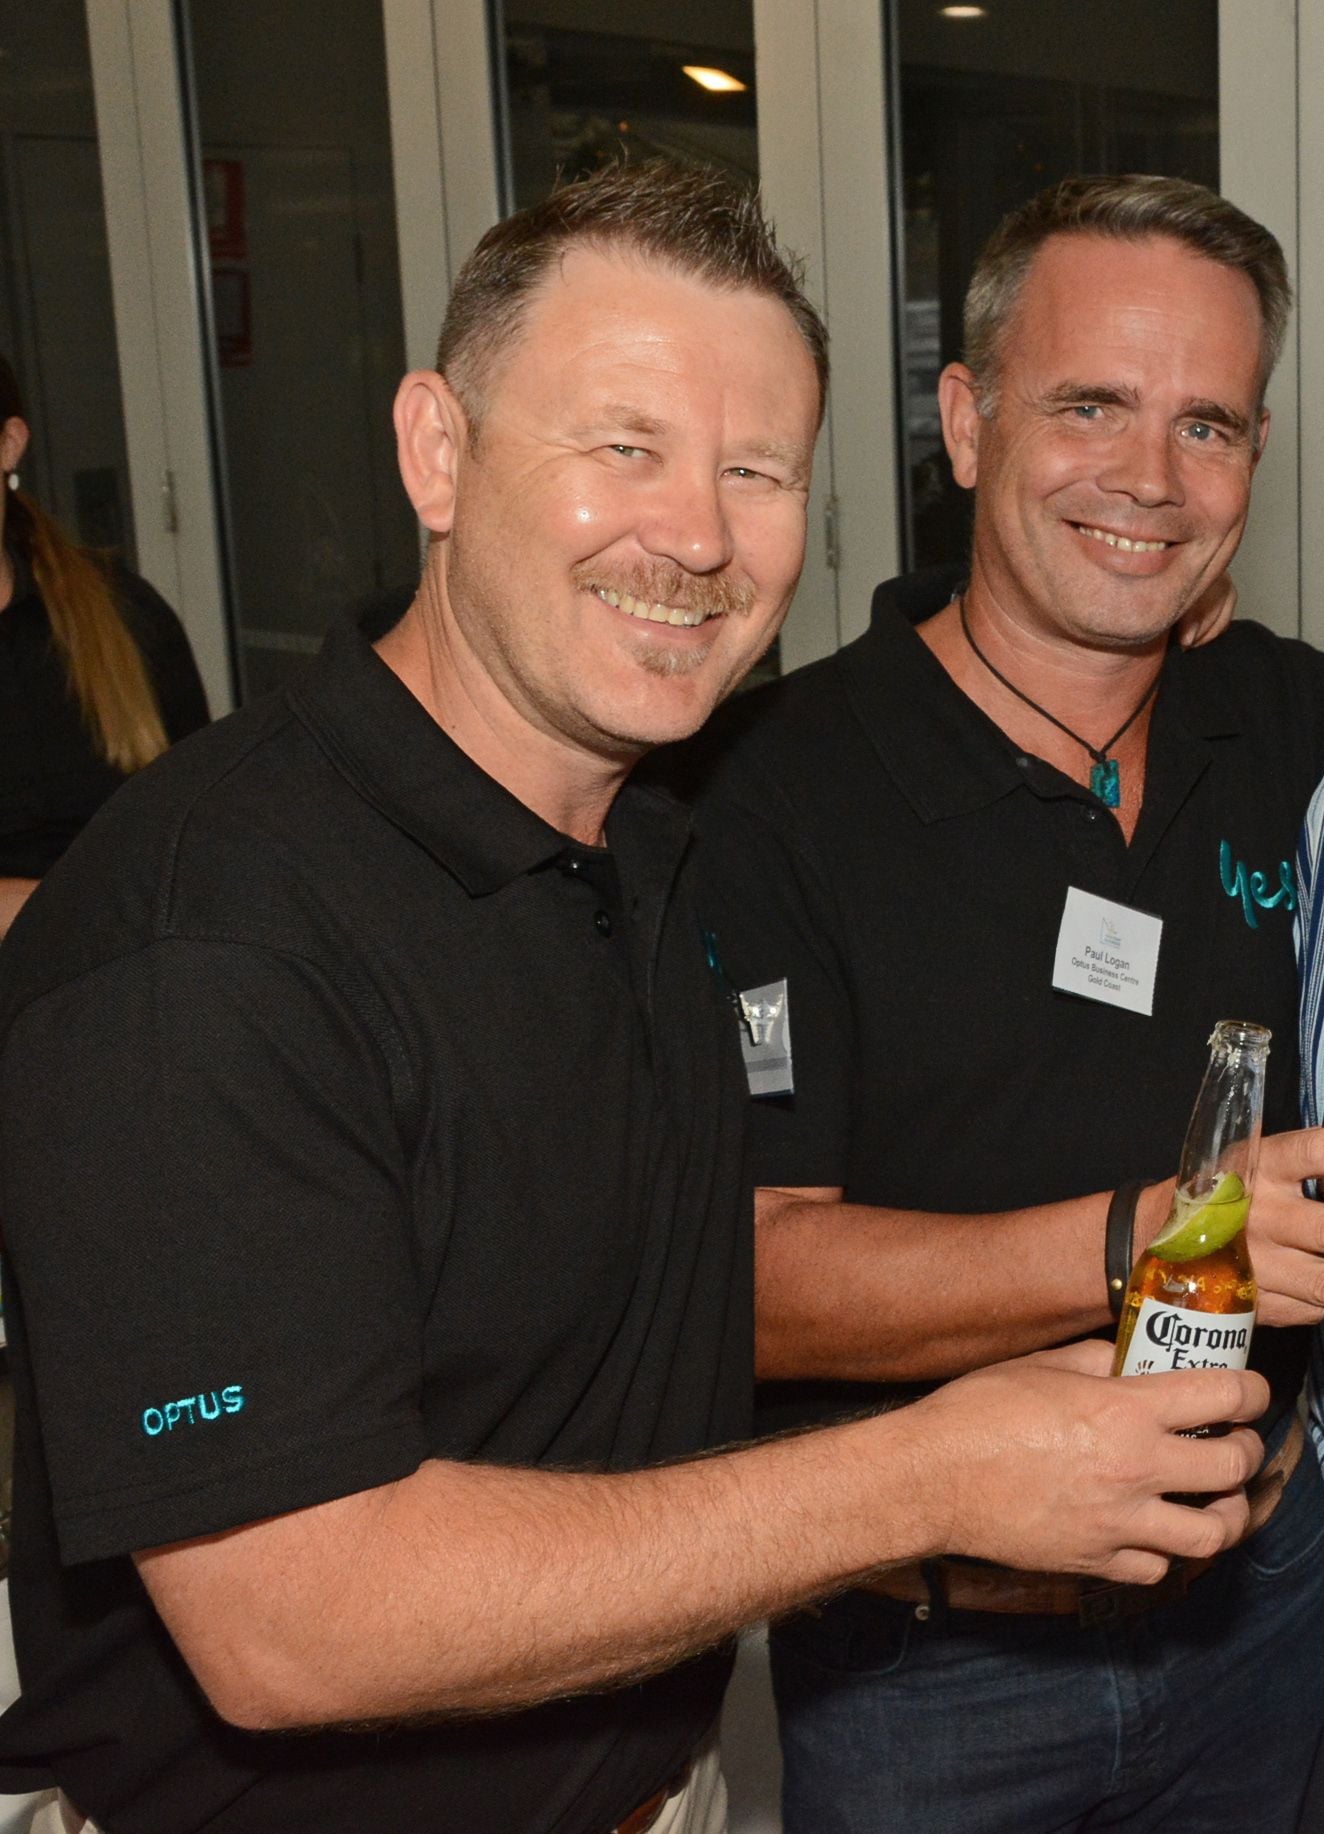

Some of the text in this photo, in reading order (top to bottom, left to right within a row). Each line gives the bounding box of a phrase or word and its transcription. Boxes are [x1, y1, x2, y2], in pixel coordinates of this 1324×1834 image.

[1071, 957, 1139, 986] Optus Business Centre
[1084, 945, 1131, 970] Paul Logan
[1087, 974, 1121, 991] Gold Coast
[1145, 1310, 1248, 1354] Corona
[142, 1385, 245, 1436] OPTUS
